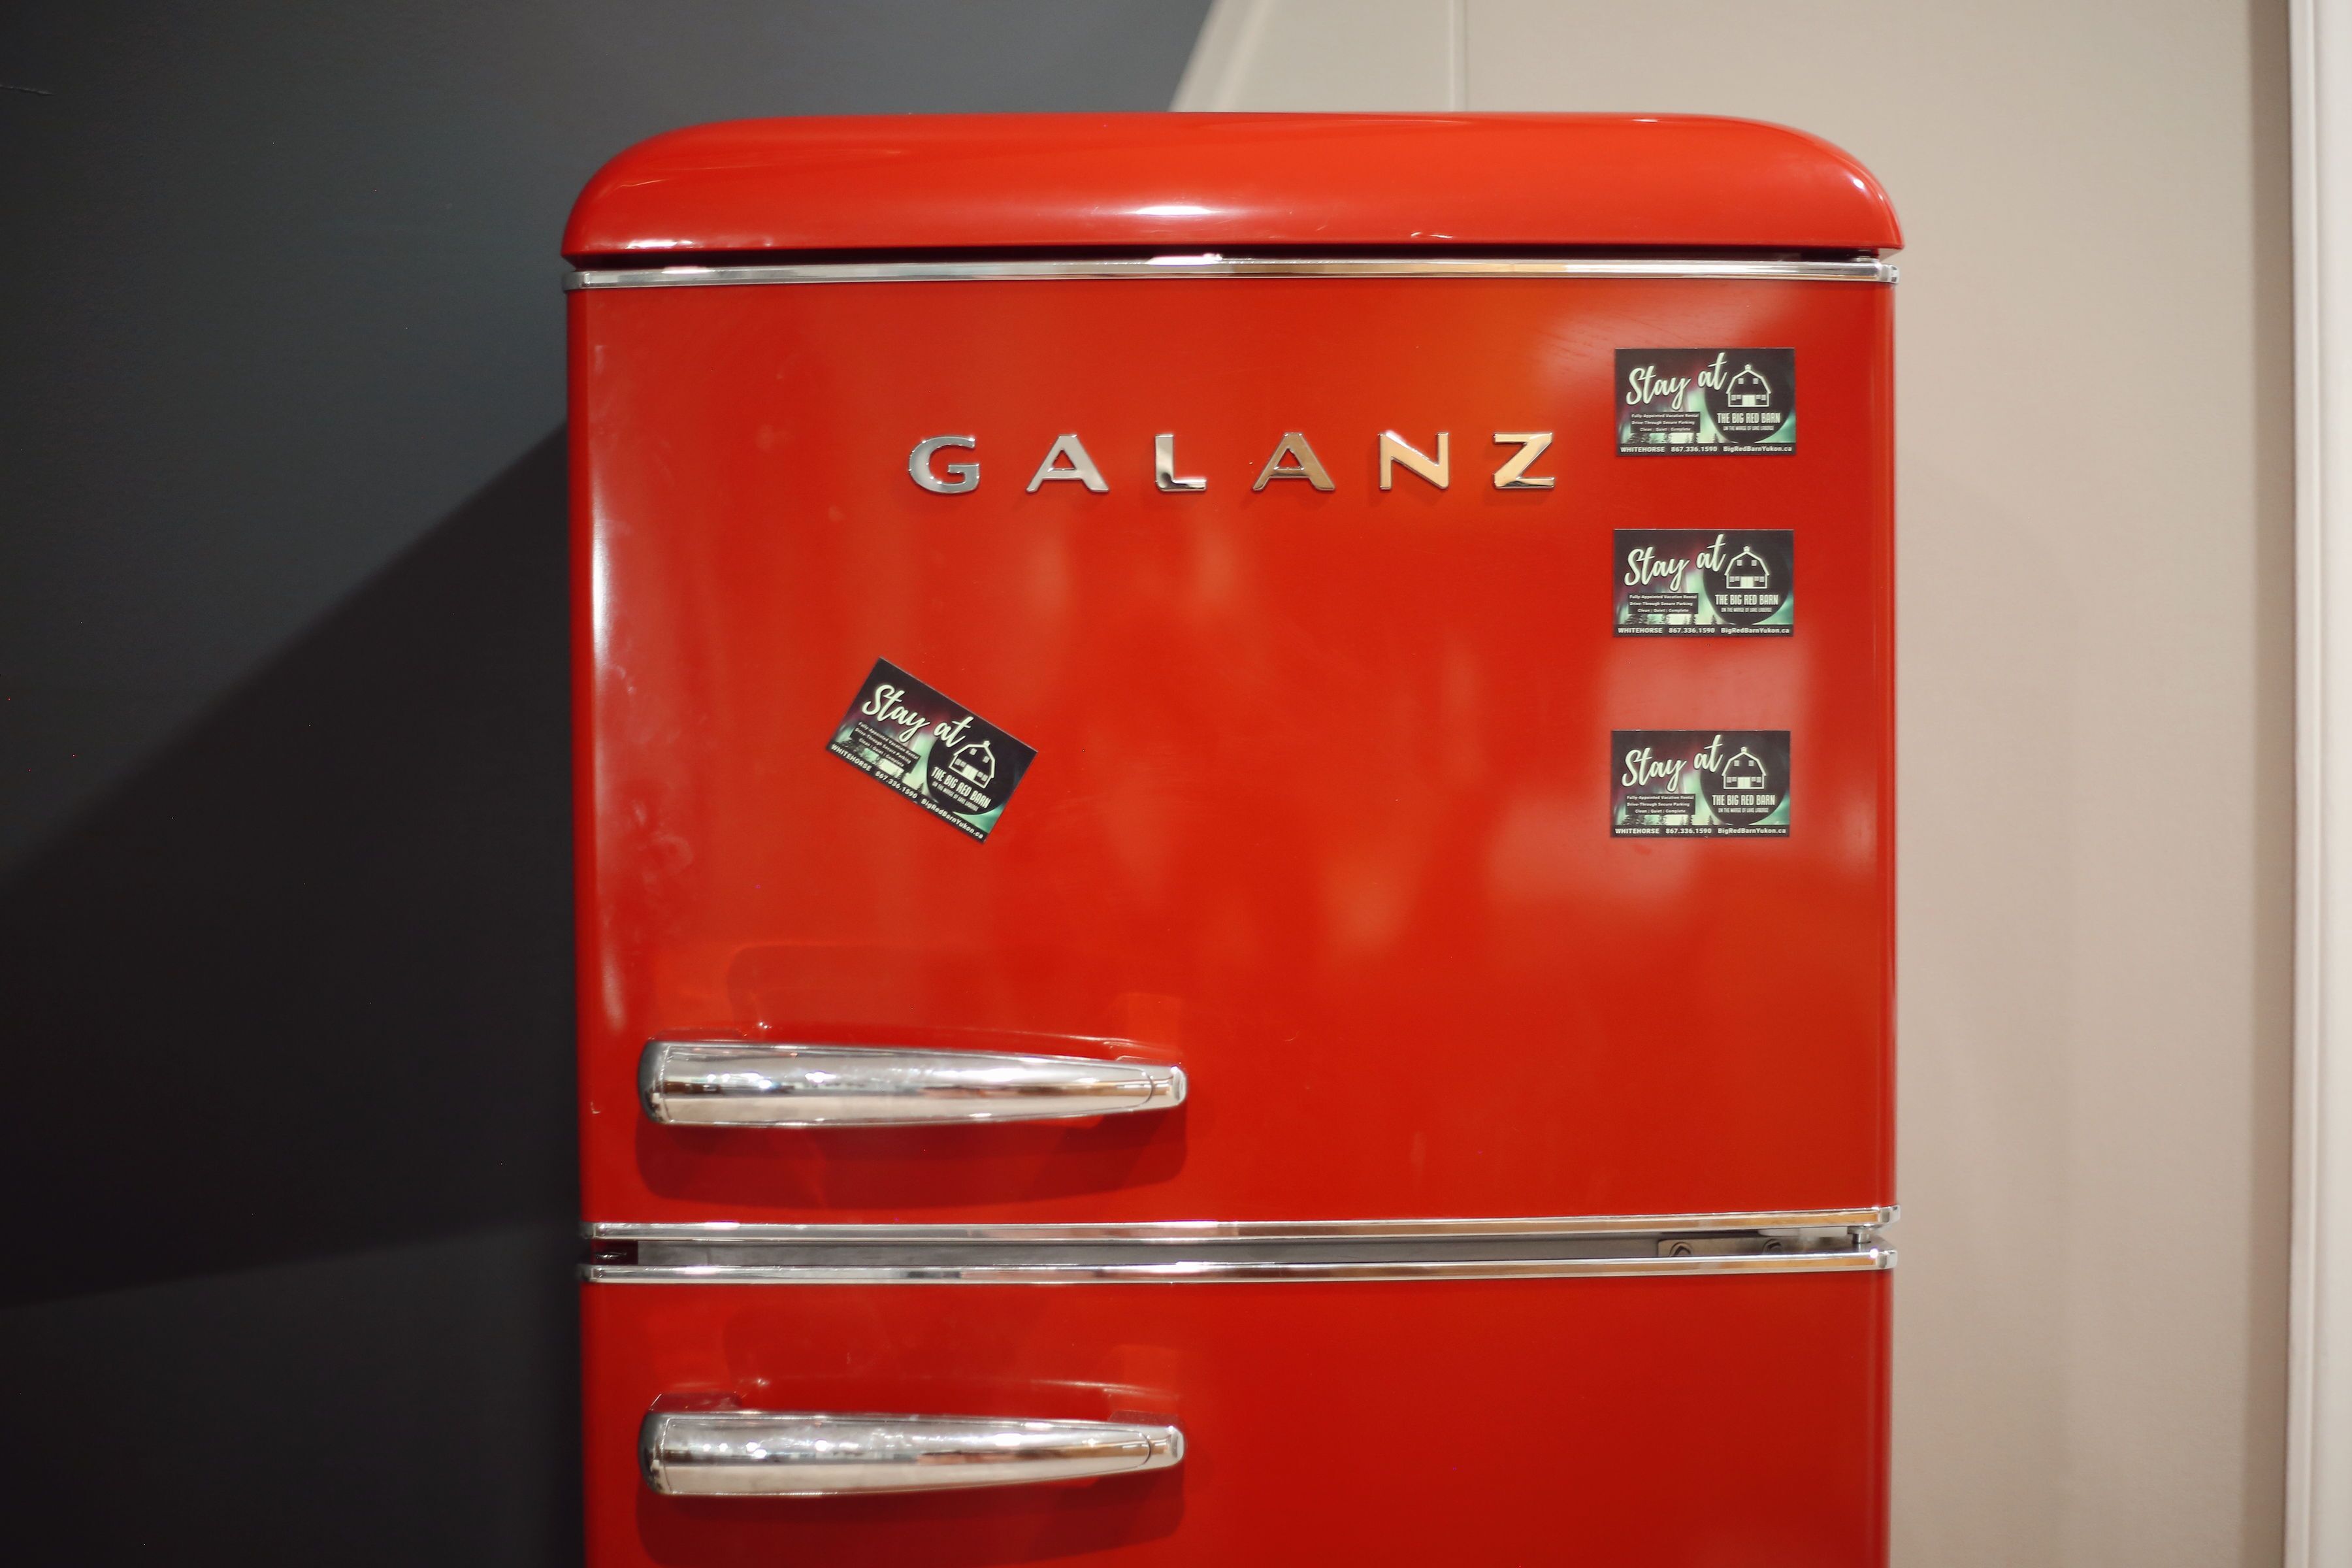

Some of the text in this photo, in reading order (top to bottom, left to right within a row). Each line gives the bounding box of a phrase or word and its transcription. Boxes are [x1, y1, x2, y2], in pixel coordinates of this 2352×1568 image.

[1625, 352, 1727, 410] Stay at
[1716, 412, 1780, 423] THE BIG RED BARN
[907, 431, 1556, 495] GALANZ
[1624, 533, 1726, 591] Stay at
[1715, 594, 1778, 604] THE BIG RED BARN
[861, 683, 974, 748] Stay at
[831, 743, 872, 772] WHITEHORSE
[875, 771, 918, 799] 867.336.1590
[931, 766, 947, 782] THE
[943, 774, 959, 789] BIG
[956, 782, 972, 797] RED
[970, 790, 992, 809] BARN
[1622, 734, 1723, 792] Stay at
[1712, 794, 1775, 806] THE BIG RED BARN
